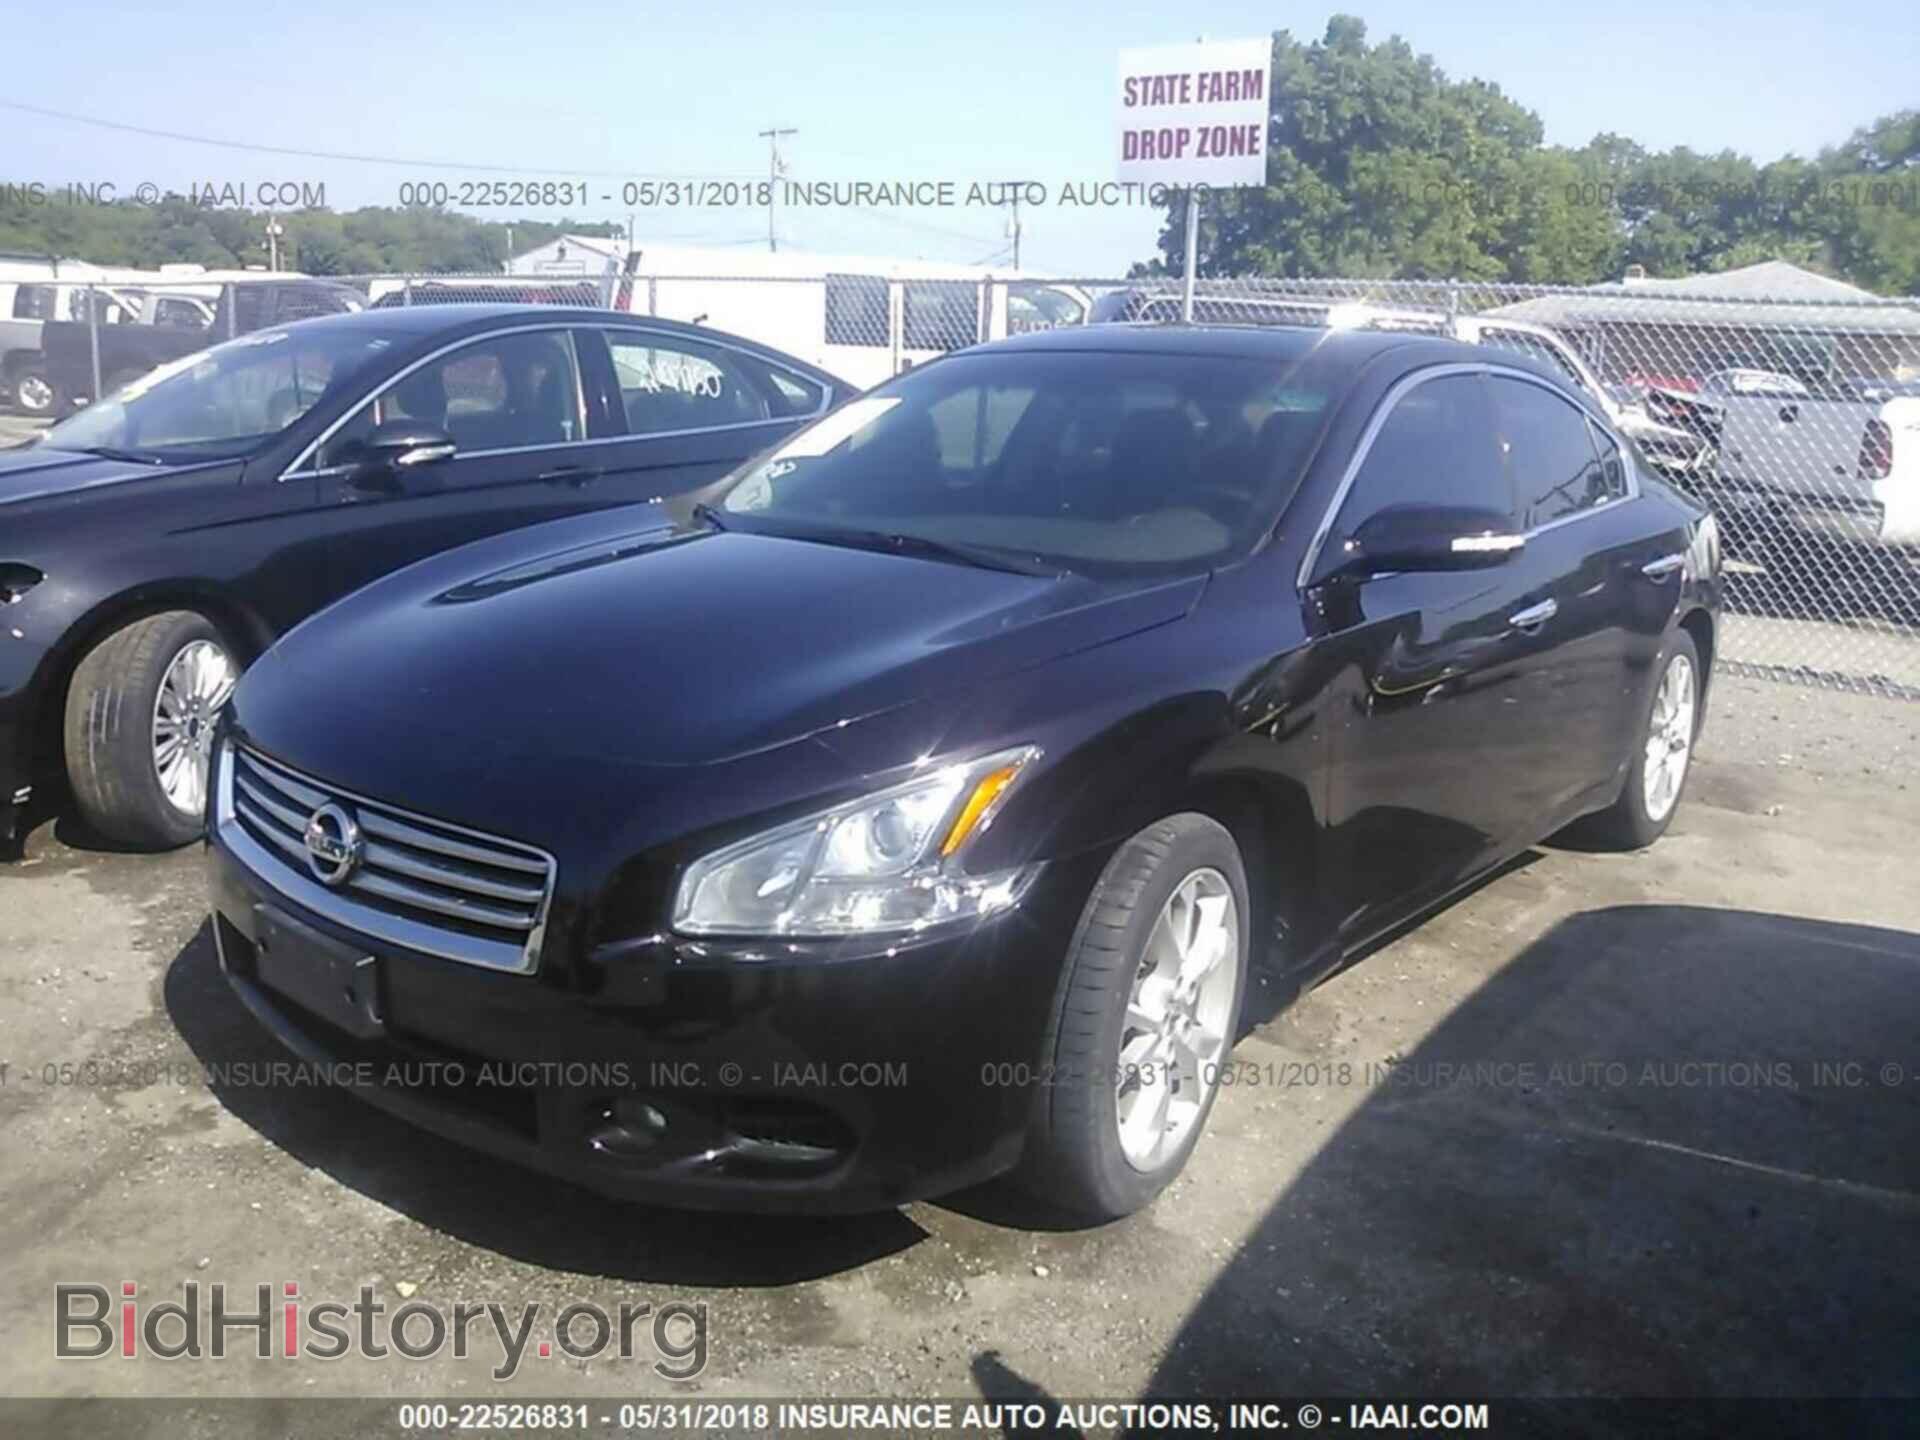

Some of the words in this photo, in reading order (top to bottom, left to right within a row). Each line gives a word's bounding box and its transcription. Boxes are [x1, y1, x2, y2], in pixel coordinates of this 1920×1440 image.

[1123, 73, 1191, 107] STATE
[1197, 69, 1263, 103] FARM
[1122, 128, 1190, 161] DROP
[1196, 124, 1261, 158] ZONE
